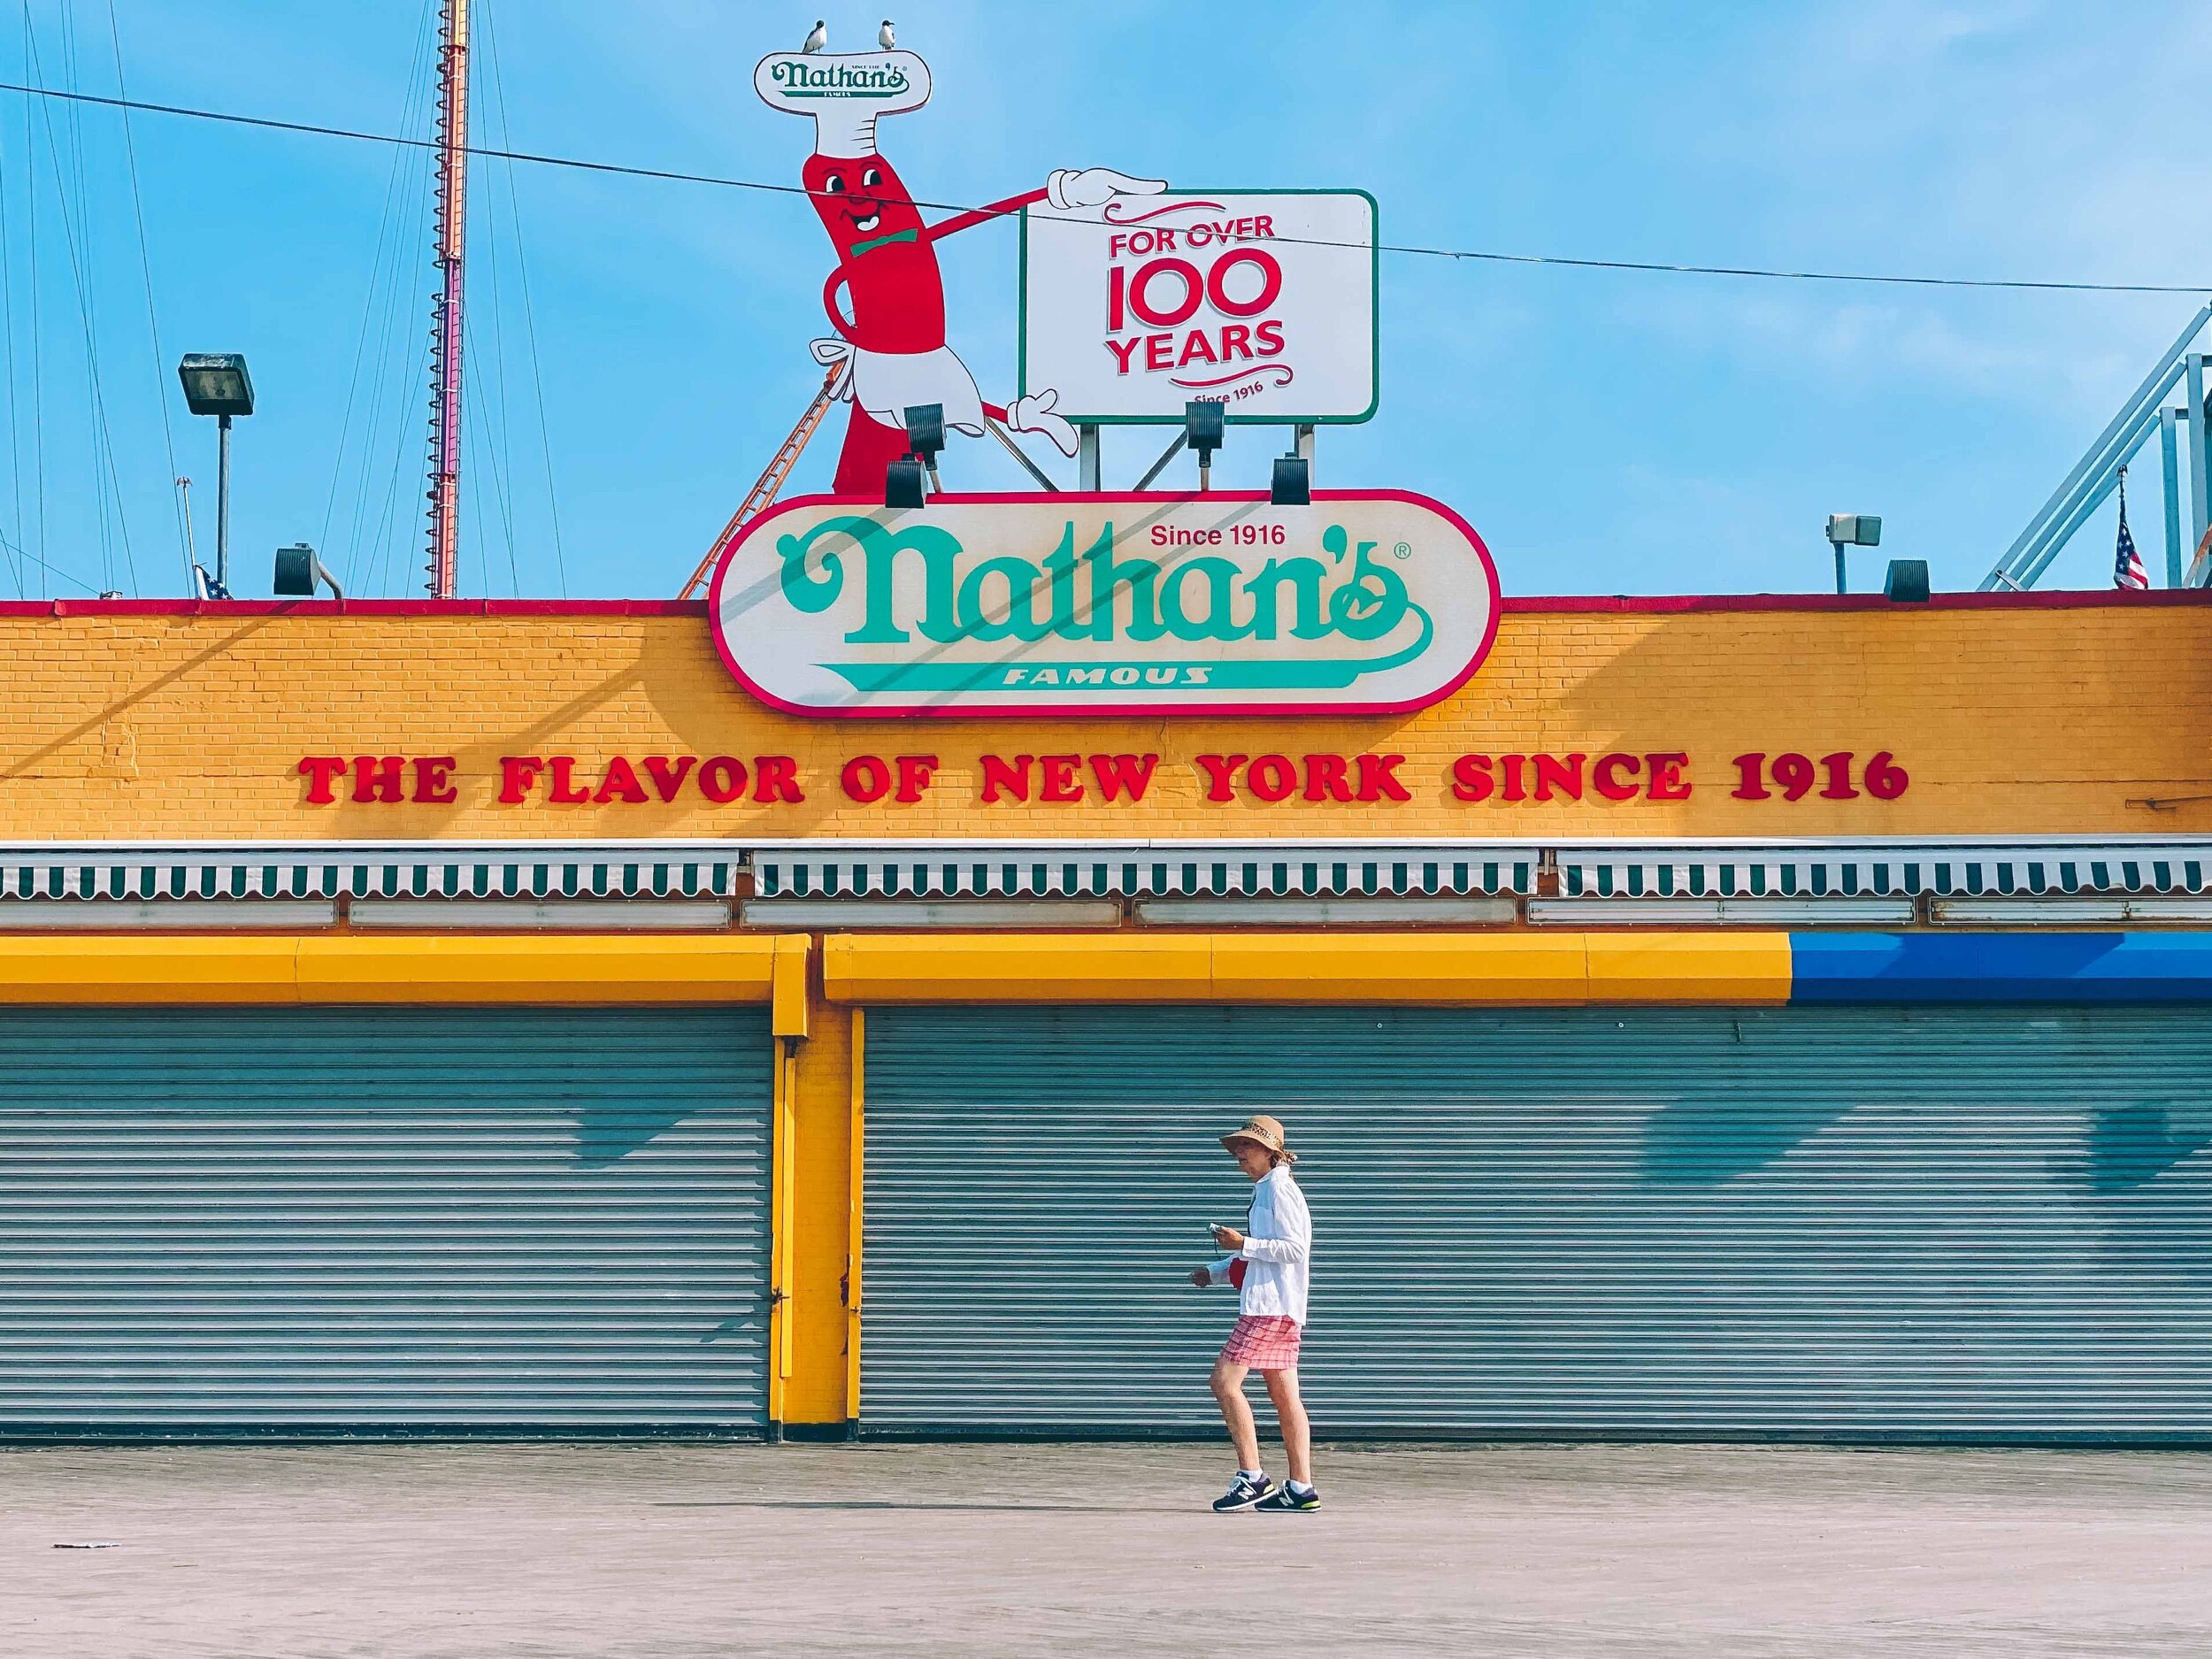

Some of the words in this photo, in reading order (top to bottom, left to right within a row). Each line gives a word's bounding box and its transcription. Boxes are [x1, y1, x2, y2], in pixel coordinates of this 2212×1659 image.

[772, 61, 905, 88] Nathan's
[1110, 229, 1177, 258] FOR
[1187, 215, 1275, 248] OVER
[1107, 248, 1282, 333] 100
[1105, 319, 1285, 375] YEARS
[1233, 380, 1263, 400] 1916
[1150, 525, 1222, 546] Since
[1229, 525, 1286, 546] 1916
[777, 515, 1409, 643] Nathan's
[1002, 666, 1212, 686] FAMOUS
[298, 755, 458, 803] THE
[498, 755, 805, 804] FLAVOR
[841, 754, 941, 803] OF
[979, 754, 1158, 803] NEW
[1194, 753, 1413, 803] YORK
[1450, 752, 1694, 803] SINCE
[1729, 751, 1909, 802] 1916
